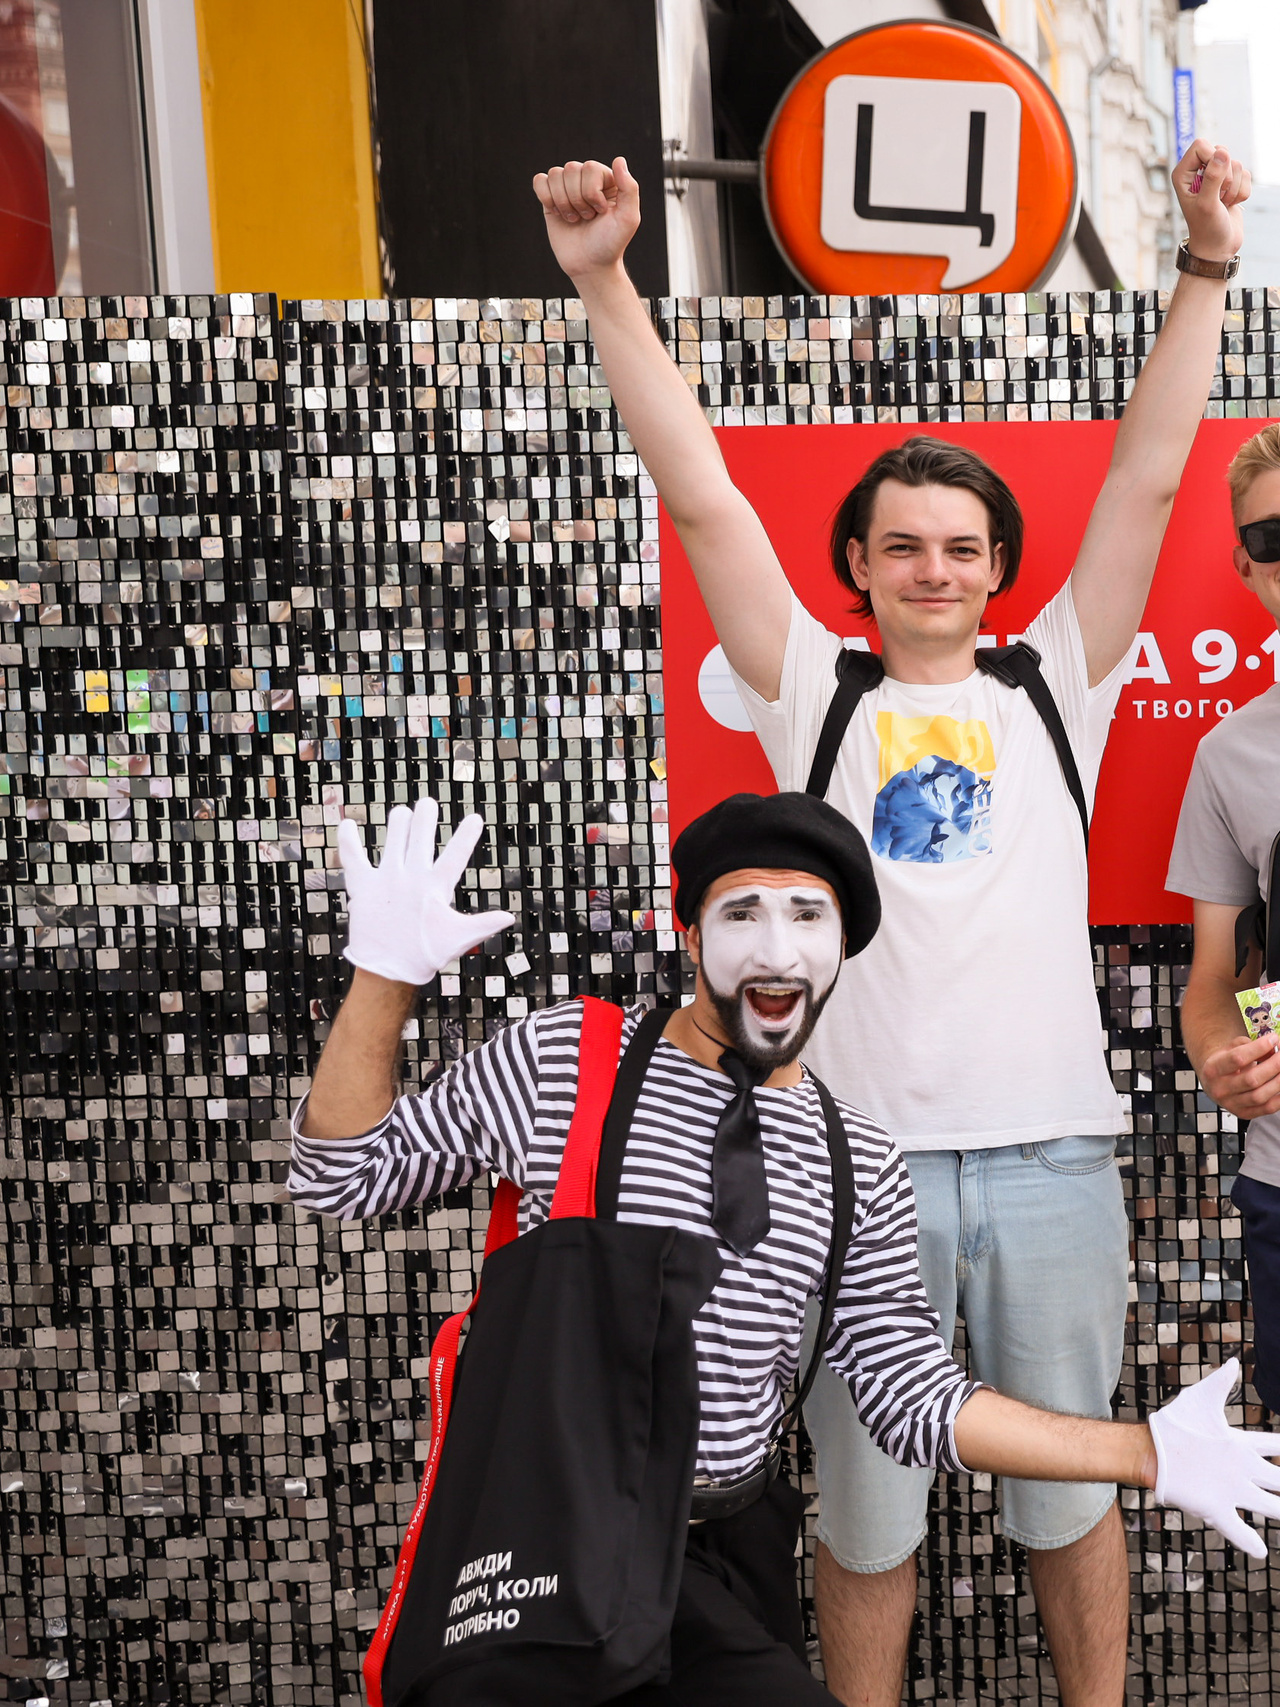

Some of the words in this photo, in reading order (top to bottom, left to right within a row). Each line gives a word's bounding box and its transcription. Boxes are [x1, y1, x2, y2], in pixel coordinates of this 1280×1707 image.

[853, 104, 995, 247] Ц
[1132, 698, 1234, 719] ТВОГО
[409, 1464, 433, 1531] ТУРБОТОЮ
[431, 1436, 440, 1462] ПРО
[456, 1551, 513, 1588] АВЖДИ
[497, 1574, 559, 1601] КОЛИ
[443, 1608, 521, 1647] ПОТРІБНО
